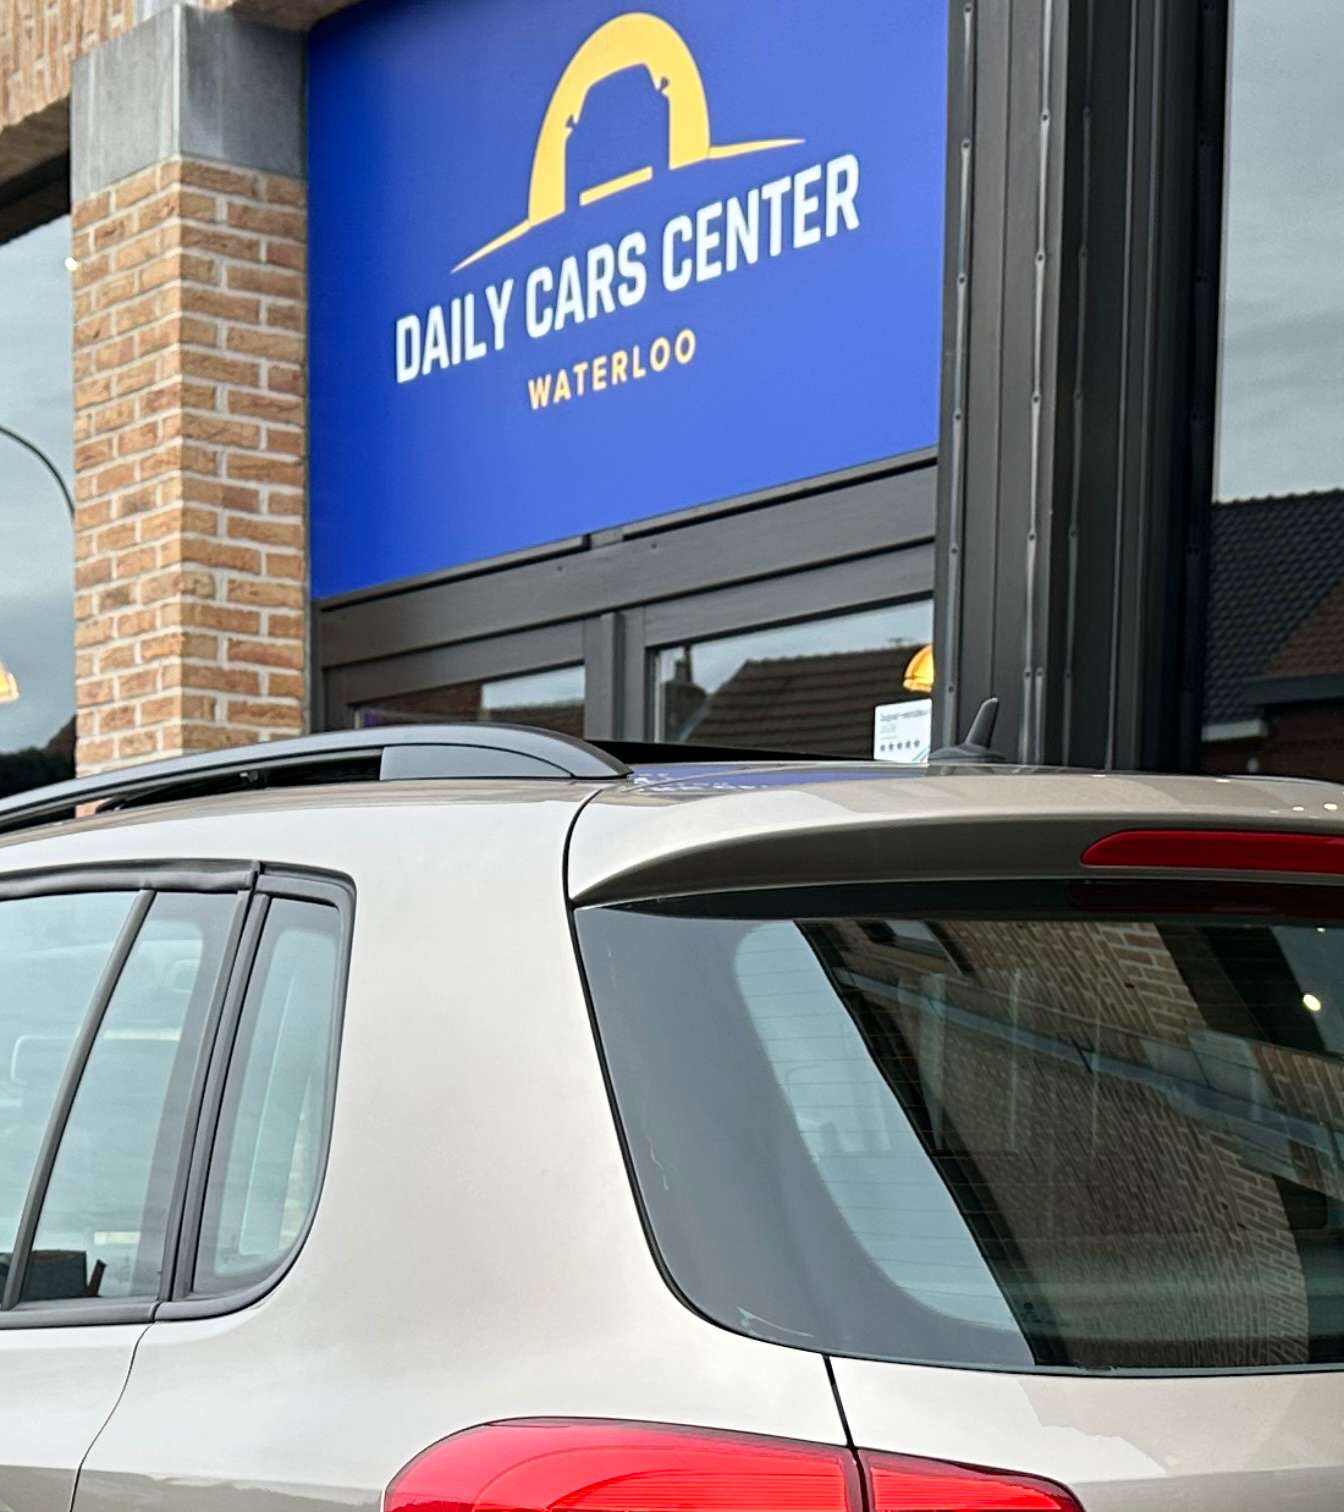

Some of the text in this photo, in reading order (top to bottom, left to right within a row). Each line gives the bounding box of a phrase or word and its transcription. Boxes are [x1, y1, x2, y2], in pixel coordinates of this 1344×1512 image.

[396, 154, 860, 384] DAILY CARS CENTER
[528, 328, 697, 411] WATERLOO
